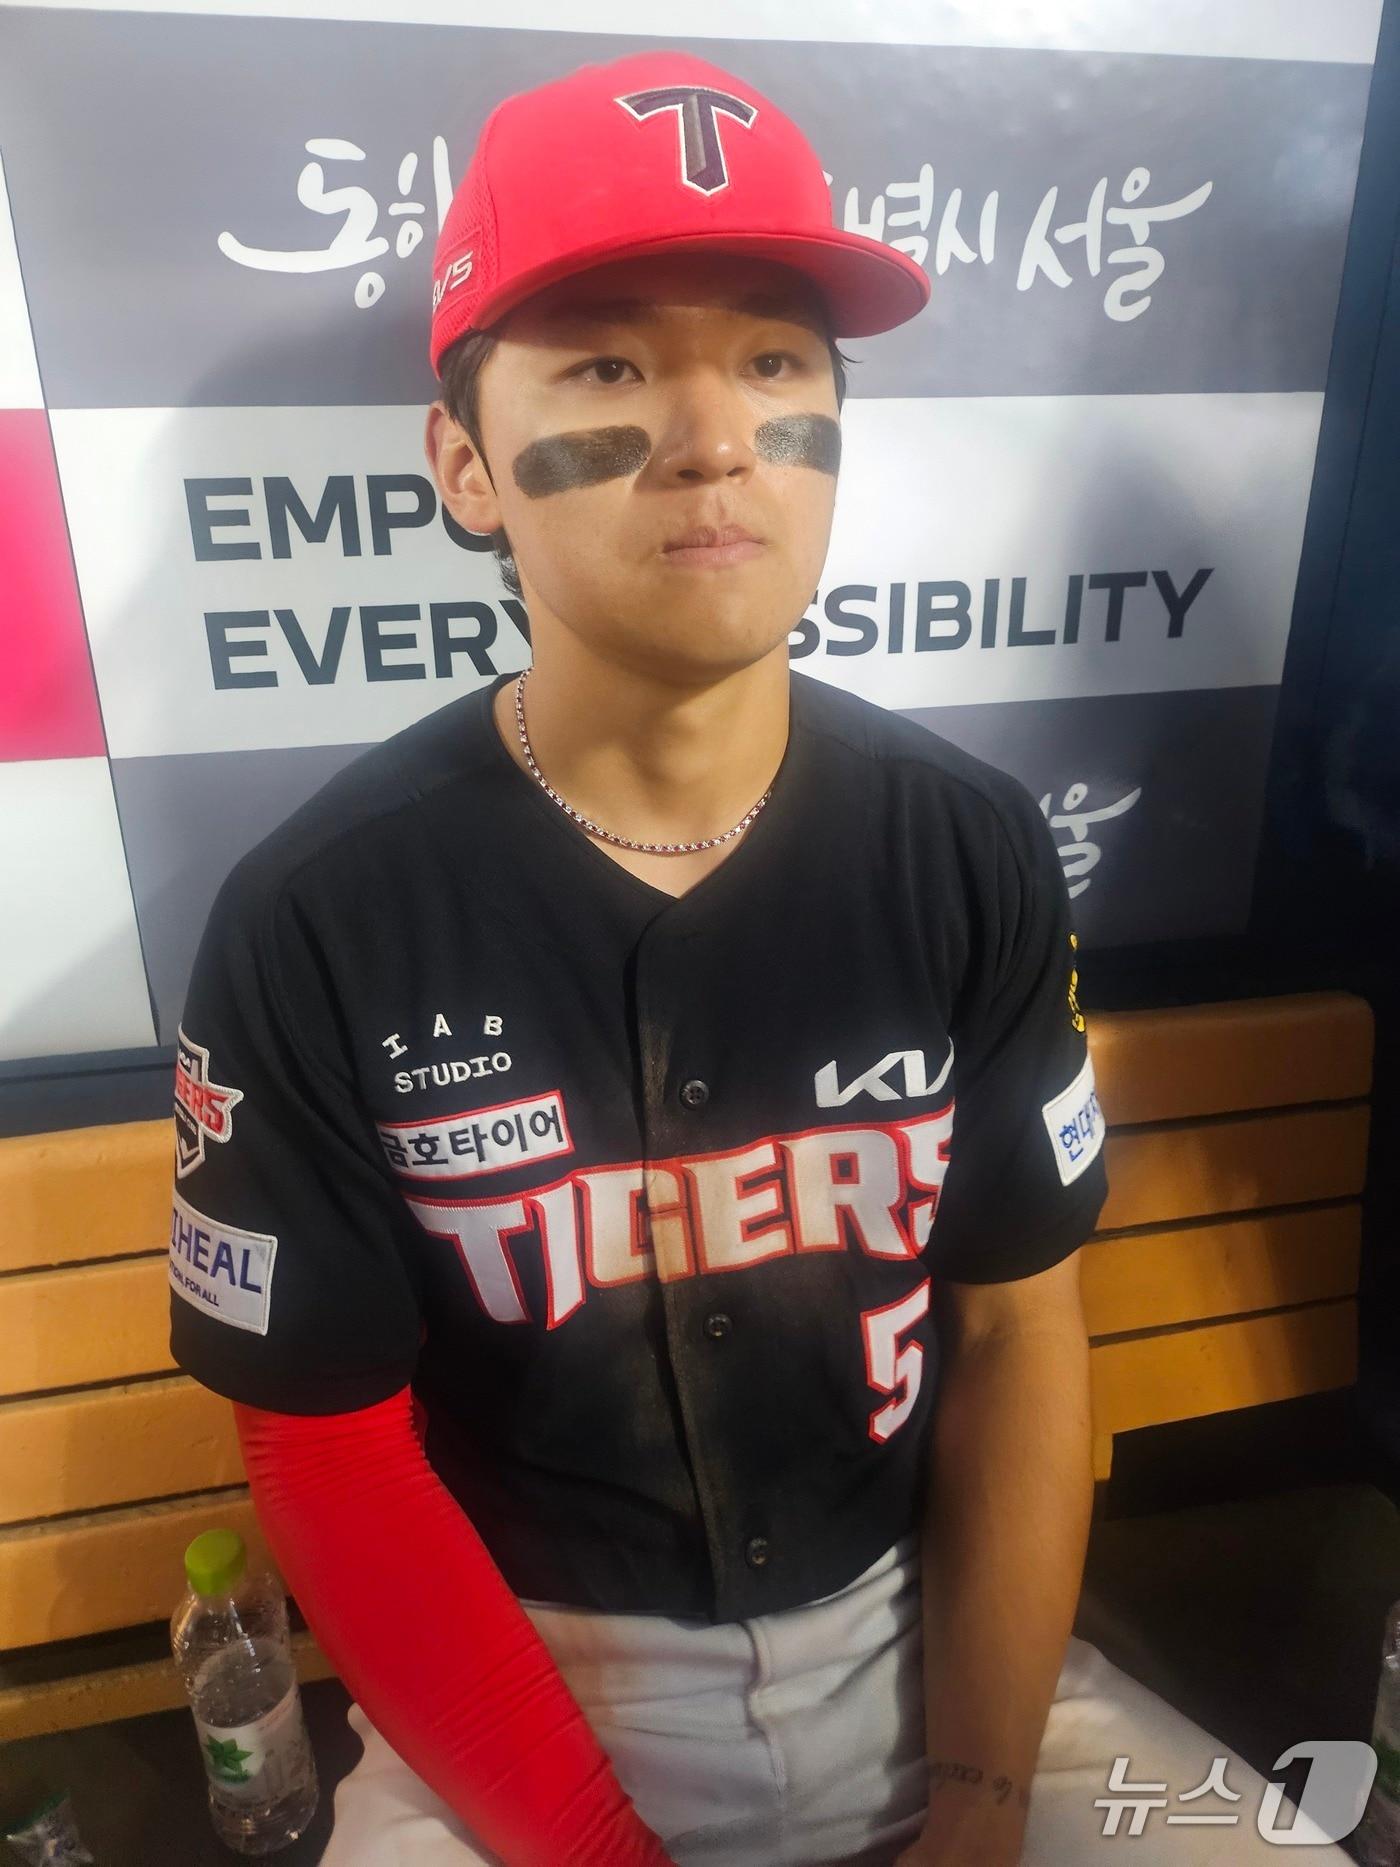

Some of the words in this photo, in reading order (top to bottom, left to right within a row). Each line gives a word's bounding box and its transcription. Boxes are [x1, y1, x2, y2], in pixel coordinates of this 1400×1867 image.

[614, 85, 758, 196] T
[1017, 166, 1213, 322] 서울
[380, 1105, 564, 1169] 금호타이어
[394, 1052, 512, 1093] STUDIO
[404, 1097, 955, 1332] TIGERS
[861, 1277, 931, 1445] 5
